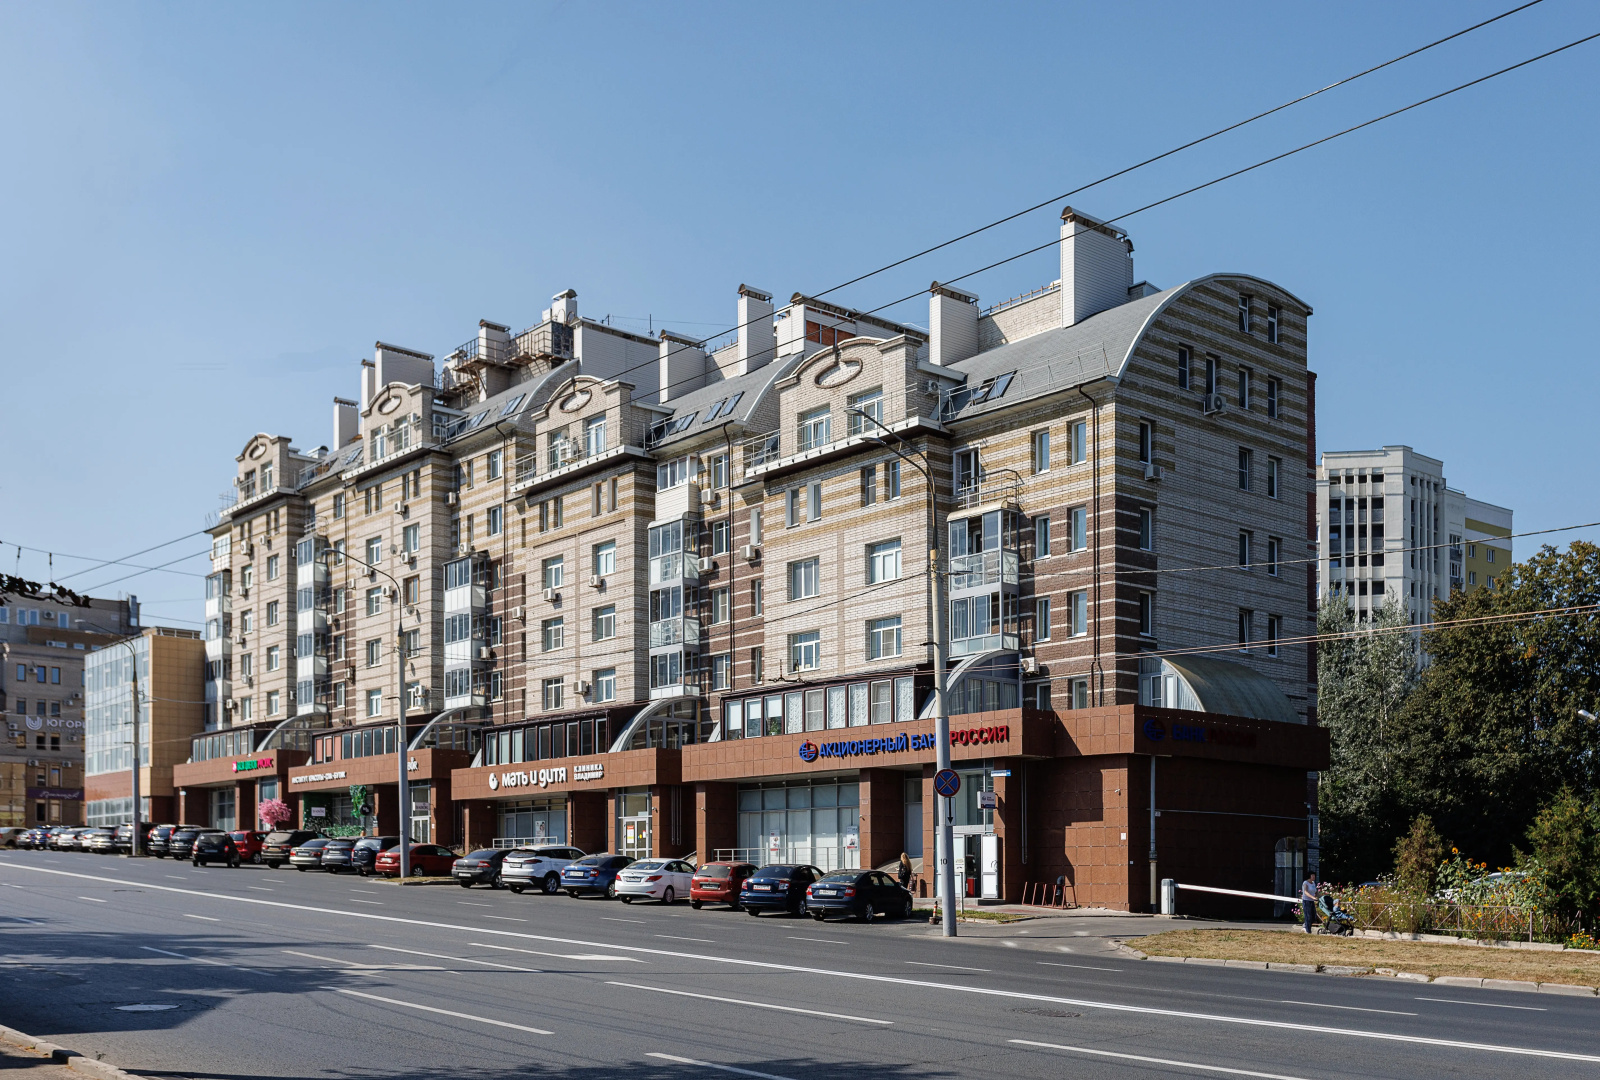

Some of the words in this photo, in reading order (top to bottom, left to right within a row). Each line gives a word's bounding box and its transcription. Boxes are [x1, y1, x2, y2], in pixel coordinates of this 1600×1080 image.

[819, 732, 907, 758] АКЦИОНЕРНЫЙ
[911, 733, 937, 749] БАН
[950, 725, 1008, 745] РОССИЯ
[574, 764, 603, 773] КЛИНИКА
[574, 771, 603, 781] ВЛАДИМИР
